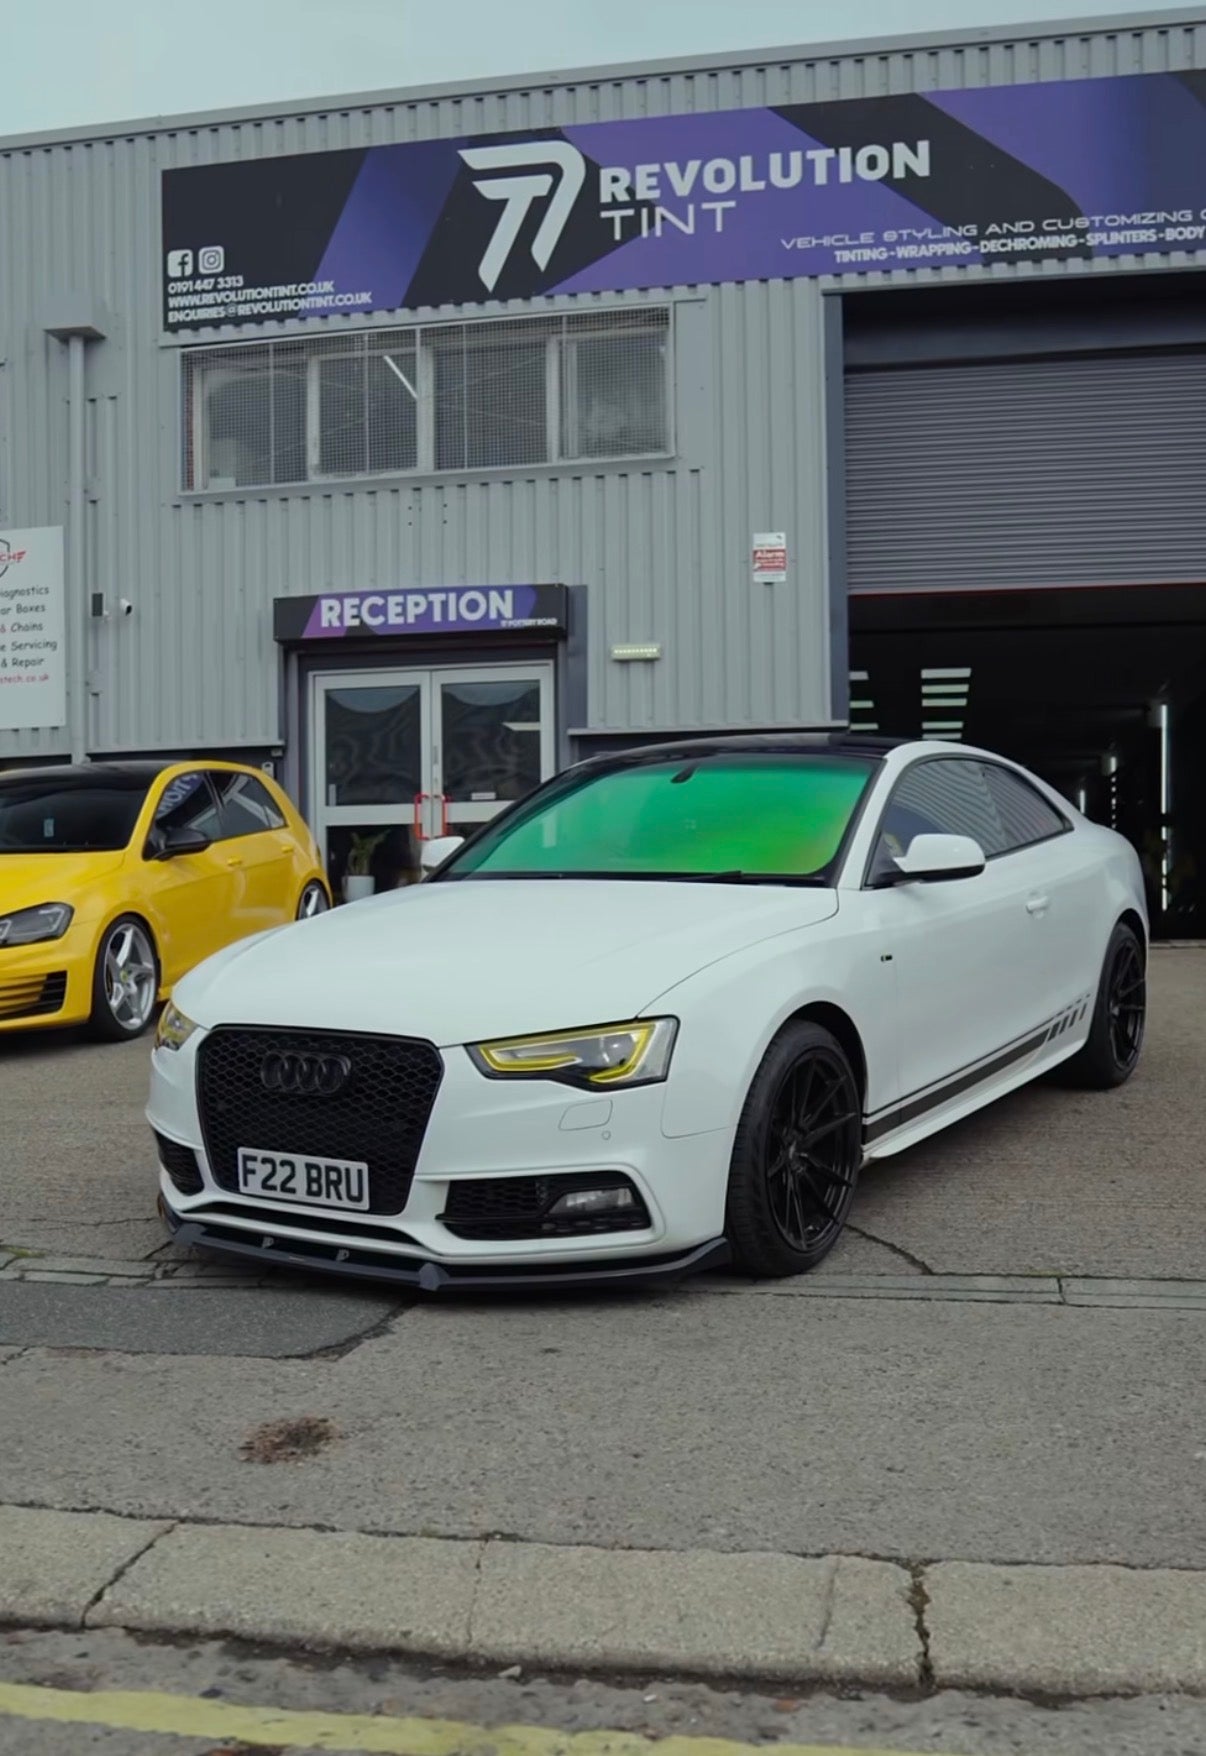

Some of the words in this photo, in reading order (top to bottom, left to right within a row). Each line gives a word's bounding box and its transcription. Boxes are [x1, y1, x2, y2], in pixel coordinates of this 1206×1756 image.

[600, 140, 930, 203] REVOLUTION
[600, 201, 736, 240] TINT
[781, 232, 875, 250] VEHICLE
[883, 224, 978, 242] STYLING
[985, 221, 1035, 236] AND
[1042, 210, 1193, 231] CUSTOMIZING
[16, 603, 45, 614] Boxes
[320, 590, 513, 627] RECEPTION
[11, 622, 43, 633] Chains
[11, 640, 57, 652] Servicing
[12, 657, 45, 670] Repair
[241, 1153, 297, 1195] F22
[304, 1162, 364, 1203] BRU
